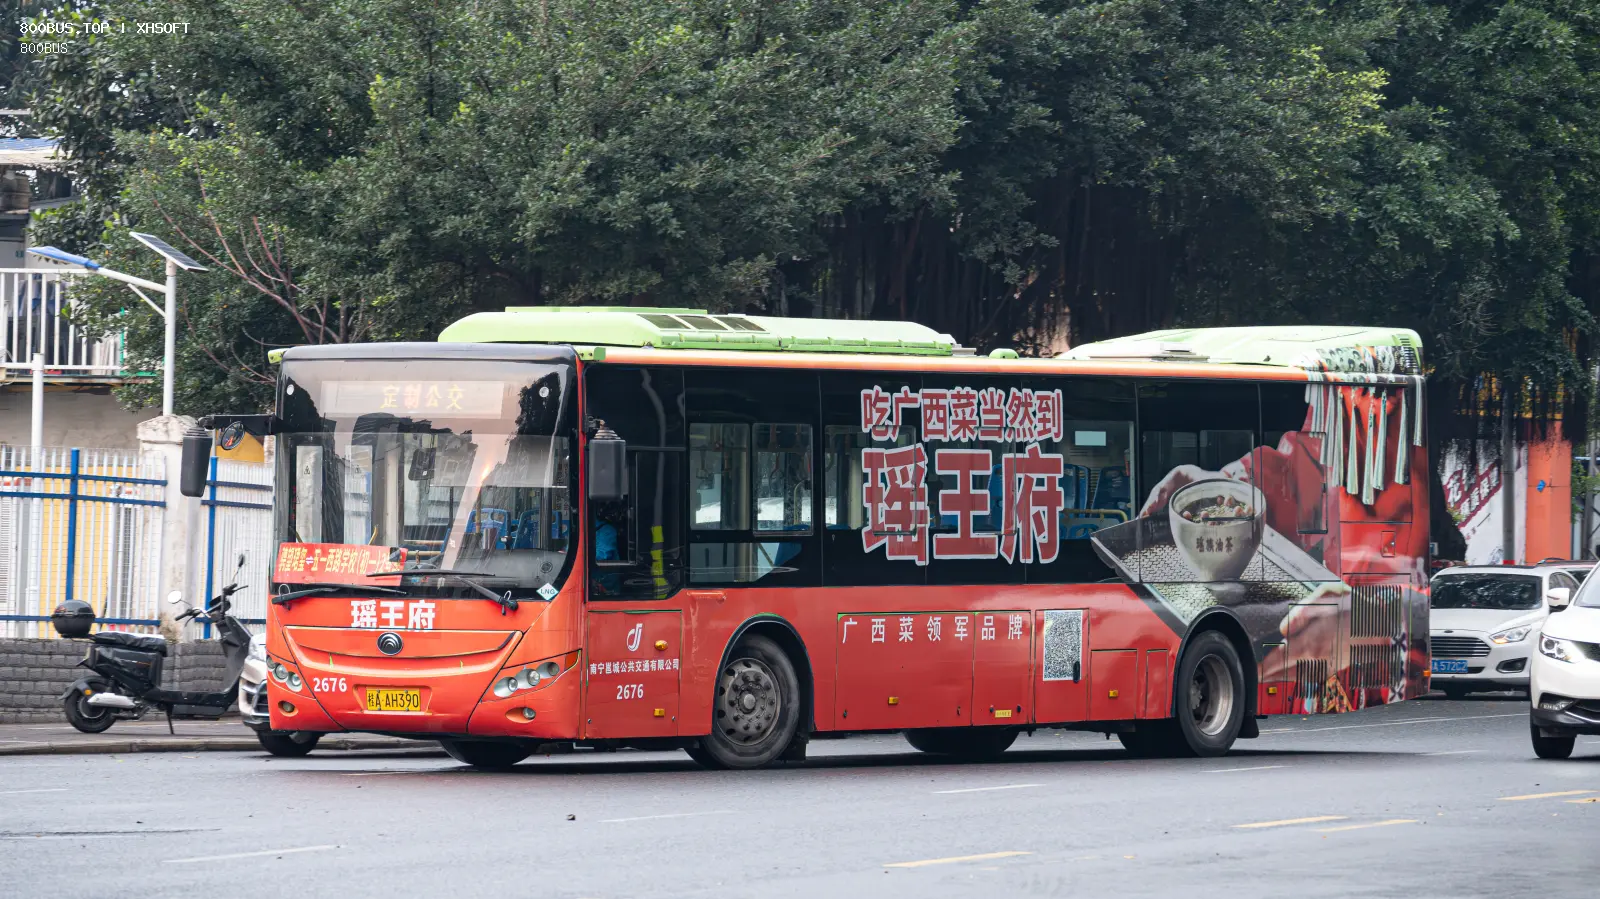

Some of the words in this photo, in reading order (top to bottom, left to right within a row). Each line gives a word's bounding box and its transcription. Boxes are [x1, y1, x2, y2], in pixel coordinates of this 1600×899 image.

[380, 384, 467, 411] 定制公交
[861, 385, 1064, 443] 吃广西菜当然到
[861, 442, 1065, 567] 瑶王府
[540, 587, 556, 595] LNG
[350, 599, 437, 633] 瑶王府
[841, 614, 1024, 644] 广西菜领军品牌
[589, 658, 680, 675] 南宁邕城公共交通有限公司
[312, 677, 348, 693] 2676
[616, 683, 644, 700] 2676
